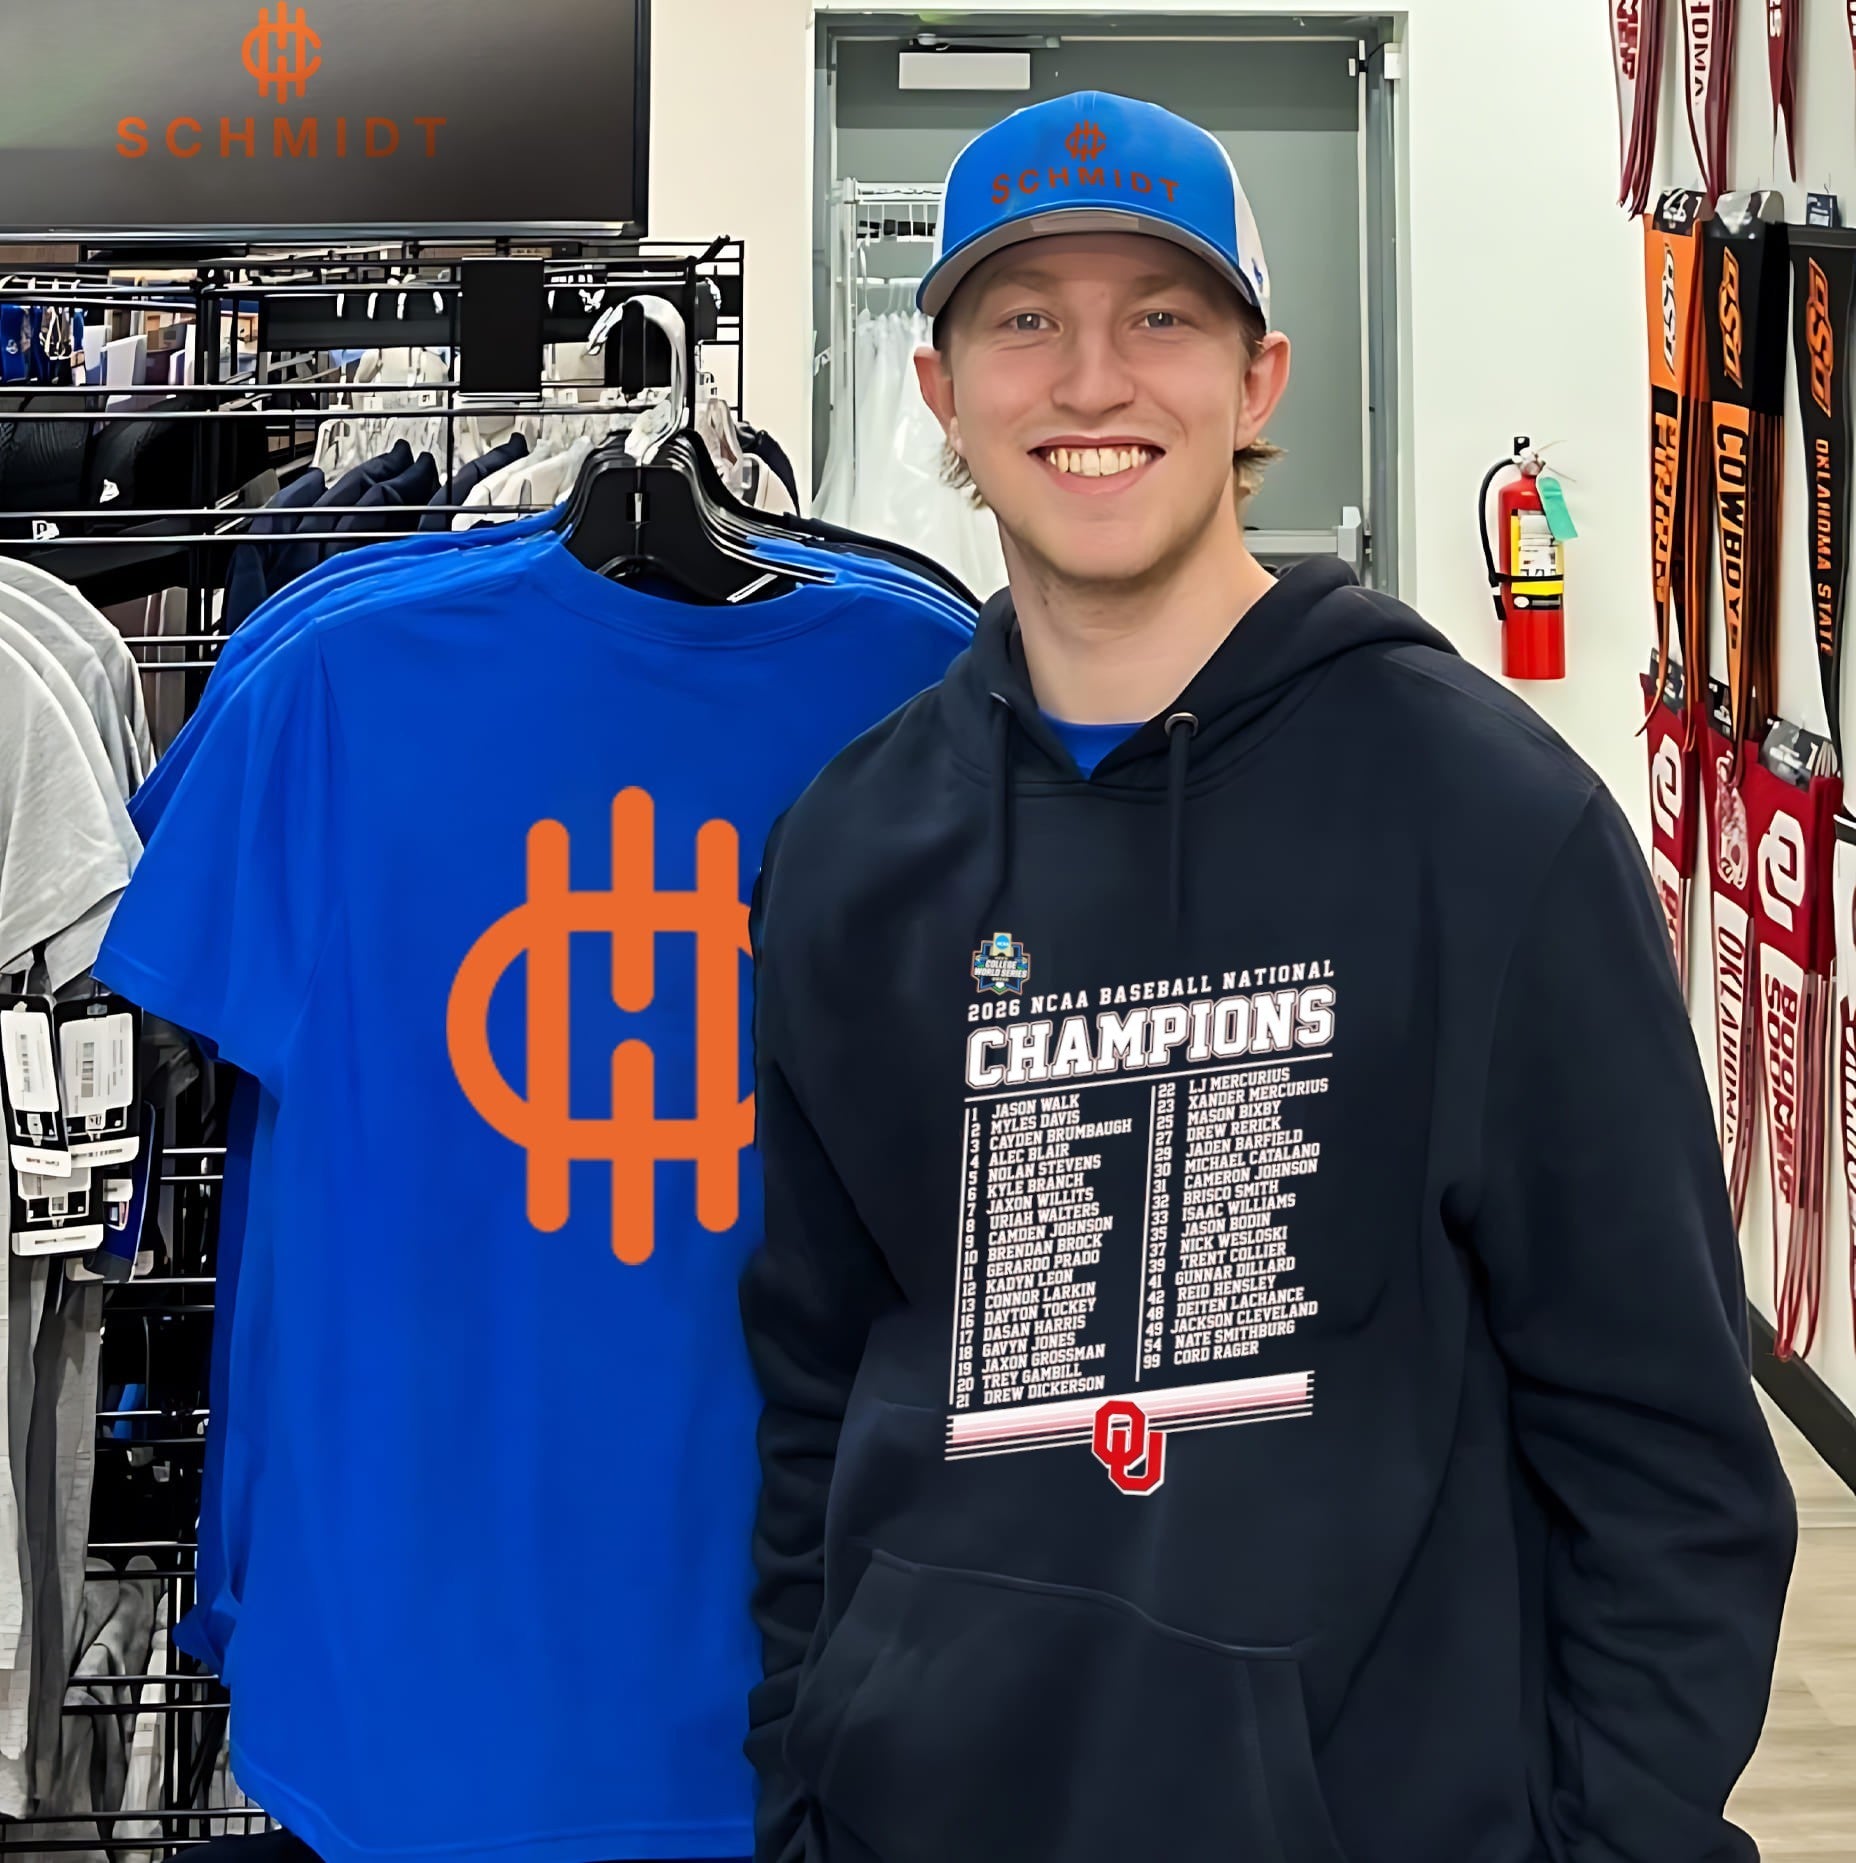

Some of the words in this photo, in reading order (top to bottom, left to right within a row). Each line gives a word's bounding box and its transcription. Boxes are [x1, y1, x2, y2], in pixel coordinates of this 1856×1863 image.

[116, 117, 447, 158] SCHMIDT
[991, 167, 1180, 205] SCHMIDT
[967, 999, 1020, 1022] 2026
[1031, 989, 1090, 1013] NCAA
[1099, 975, 1212, 1006] BASEBALL
[1222, 959, 1335, 990] NATIONAL
[965, 985, 1336, 1089] CHAMPIONS
[1157, 1098, 1175, 1114] 23
[1188, 1088, 1246, 1109] XANDER
[1248, 1078, 1329, 1102] MERCURIUS
[1158, 1082, 1176, 1098] 22
[1188, 1078, 1208, 1094] LJ
[1209, 1066, 1290, 1091] MERCURIUS
[971, 1122, 981, 1137] 2
[990, 1115, 1037, 1135] MYLES
[1039, 1109, 1081, 1128] DAVIS
[972, 1107, 978, 1121] 1
[991, 1099, 1037, 1119] JASON
[1040, 1093, 1080, 1112] WALK
[1156, 1114, 1174, 1130] 25
[1187, 1105, 1236, 1126] MASON
[1238, 1100, 1282, 1118] BIXBY
[970, 1138, 980, 1153] 3
[989, 1130, 1044, 1150] CAYDEN
[1046, 1118, 1133, 1143] BRUMBAUGH
[1154, 1146, 1173, 1161] 29
[1185, 1138, 1232, 1157] JADEN
[1234, 1128, 1304, 1151] BARFIELD
[1155, 1130, 1174, 1146] 27
[1186, 1122, 1228, 1142] DREW
[1230, 1115, 1282, 1135] RERICK
[968, 1170, 978, 1185] 5
[987, 1162, 1036, 1183] NOLAN
[1038, 1154, 1102, 1175] STEVENS
[969, 1154, 980, 1168] 4
[988, 1148, 1026, 1166] ALEC
[1027, 1142, 1070, 1161] BLAIR
[1153, 1162, 1172, 1177] 30
[1184, 1152, 1246, 1173] MICHAEL
[1249, 1142, 1320, 1165] CATALANO
[968, 1186, 978, 1201] 6
[986, 1180, 1025, 1198] KYLE
[1026, 1172, 1085, 1193] BRANCH
[1152, 1178, 1167, 1193] 31
[1184, 1167, 1252, 1189] CAMERON
[1254, 1158, 1318, 1180] JOHNSON
[967, 1202, 977, 1217] 7
[986, 1194, 1034, 1214] JAXON
[1036, 1186, 1094, 1207] WILLITS
[1150, 1210, 1169, 1225] 33
[1182, 1202, 1224, 1221] ISAAC
[1227, 1192, 1296, 1215] WILLIAMS
[1152, 1194, 1170, 1209] 32
[1182, 1185, 1232, 1205] BRISCO
[1234, 1179, 1280, 1198] SMITH
[965, 1234, 975, 1249] 9
[988, 1224, 1047, 1245] CAMDEN
[1049, 1215, 1114, 1237] JOHNSON
[966, 1218, 976, 1233] 8
[990, 1210, 1034, 1229] URIAH
[1037, 1201, 1100, 1223] WALTERS
[1150, 1225, 1168, 1241] 35
[1180, 1217, 1227, 1237] JASON
[1229, 1211, 1272, 1231] BODIN
[964, 1249, 979, 1265] 10
[987, 1239, 1054, 1261] BRENDAN
[1056, 1232, 1104, 1253] BROCK
[1148, 1257, 1166, 1273] 39
[1179, 1249, 1228, 1269] TRENT
[1230, 1241, 1287, 1262] COLLIER
[1149, 1242, 1167, 1257] 37
[1180, 1235, 1215, 1253] NICK
[1217, 1225, 1288, 1248] WESLOSKI
[963, 1266, 974, 1281] 11
[986, 1256, 1051, 1277] GERARDO
[1053, 1249, 1100, 1269] PRADO
[1147, 1274, 1162, 1289] 41
[1174, 1264, 1233, 1285] GUNNAR
[1235, 1256, 1296, 1277] DILLARD
[962, 1281, 977, 1297] 12
[985, 1273, 1035, 1293] KADYN
[1037, 1268, 1074, 1287] LEON
[962, 1298, 976, 1313] 13
[984, 1288, 1040, 1309] CONNOR
[1042, 1281, 1097, 1301] LARKIN
[1146, 1290, 1166, 1305] 42
[1177, 1283, 1211, 1301] REID
[1213, 1274, 1277, 1296] HENSLEY
[961, 1313, 975, 1329] 16
[984, 1304, 1039, 1325] DAYTON
[1042, 1296, 1097, 1317] TOCKEY
[1145, 1321, 1164, 1337] 49
[1170, 1311, 1234, 1333] JACKSON
[1236, 1300, 1318, 1325] CLEVELAND
[1146, 1305, 1165, 1321] 48
[1176, 1296, 1228, 1317] DEITEN
[1230, 1286, 1305, 1309] LACHANCE
[960, 1329, 974, 1344] 17
[982, 1322, 1032, 1341] DASAN
[1034, 1314, 1086, 1335] HARRIS
[1144, 1337, 1162, 1353] 54
[1174, 1330, 1212, 1349] NATE
[1214, 1319, 1296, 1343] SMITHBURG
[958, 1361, 973, 1376] 19
[981, 1353, 1029, 1373] JAXON
[1031, 1343, 1106, 1367] GROSSMAN
[959, 1345, 974, 1360] 18
[982, 1338, 1028, 1357] GAVYN
[1030, 1331, 1076, 1351] JONES
[1143, 1353, 1161, 1369] 99
[1173, 1346, 1211, 1365] CORD
[1212, 1340, 1260, 1359] RAGER
[956, 1393, 970, 1408] 21
[983, 1386, 1025, 1404] DREW
[1027, 1375, 1106, 1399] DICKERSON
[957, 1376, 975, 1393] 20
[982, 1370, 1020, 1389] TREY
[1022, 1362, 1083, 1383] GAMBILL
[1092, 1400, 1167, 1496] OU
